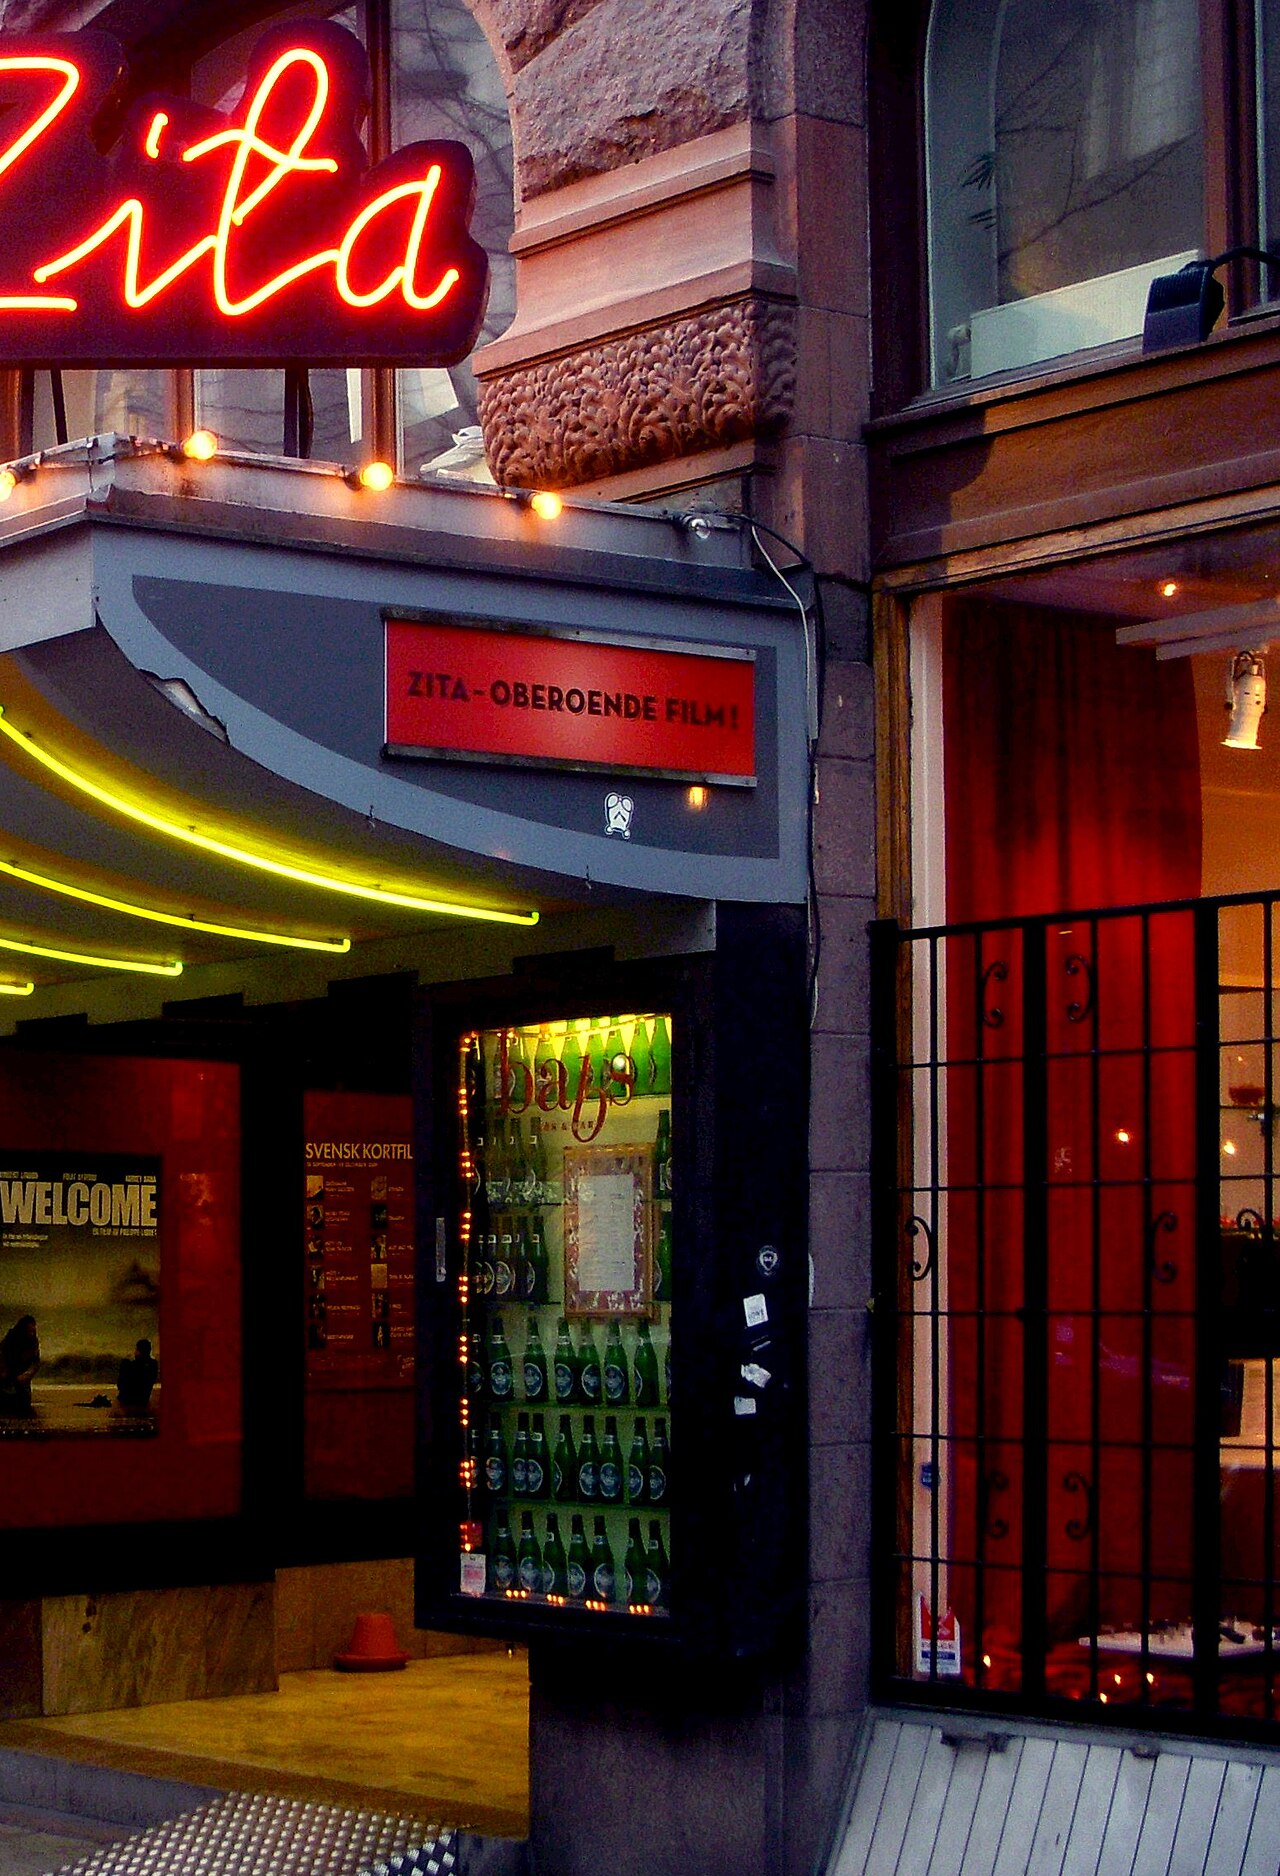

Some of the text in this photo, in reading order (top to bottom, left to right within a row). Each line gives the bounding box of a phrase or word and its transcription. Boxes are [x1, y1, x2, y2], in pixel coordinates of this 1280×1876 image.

[665, 698, 739, 730] FILM!
[496, 1028, 636, 1143] babs
[305, 1143, 361, 1160] SVENSK
[0, 1180, 158, 1227] WELCOME
